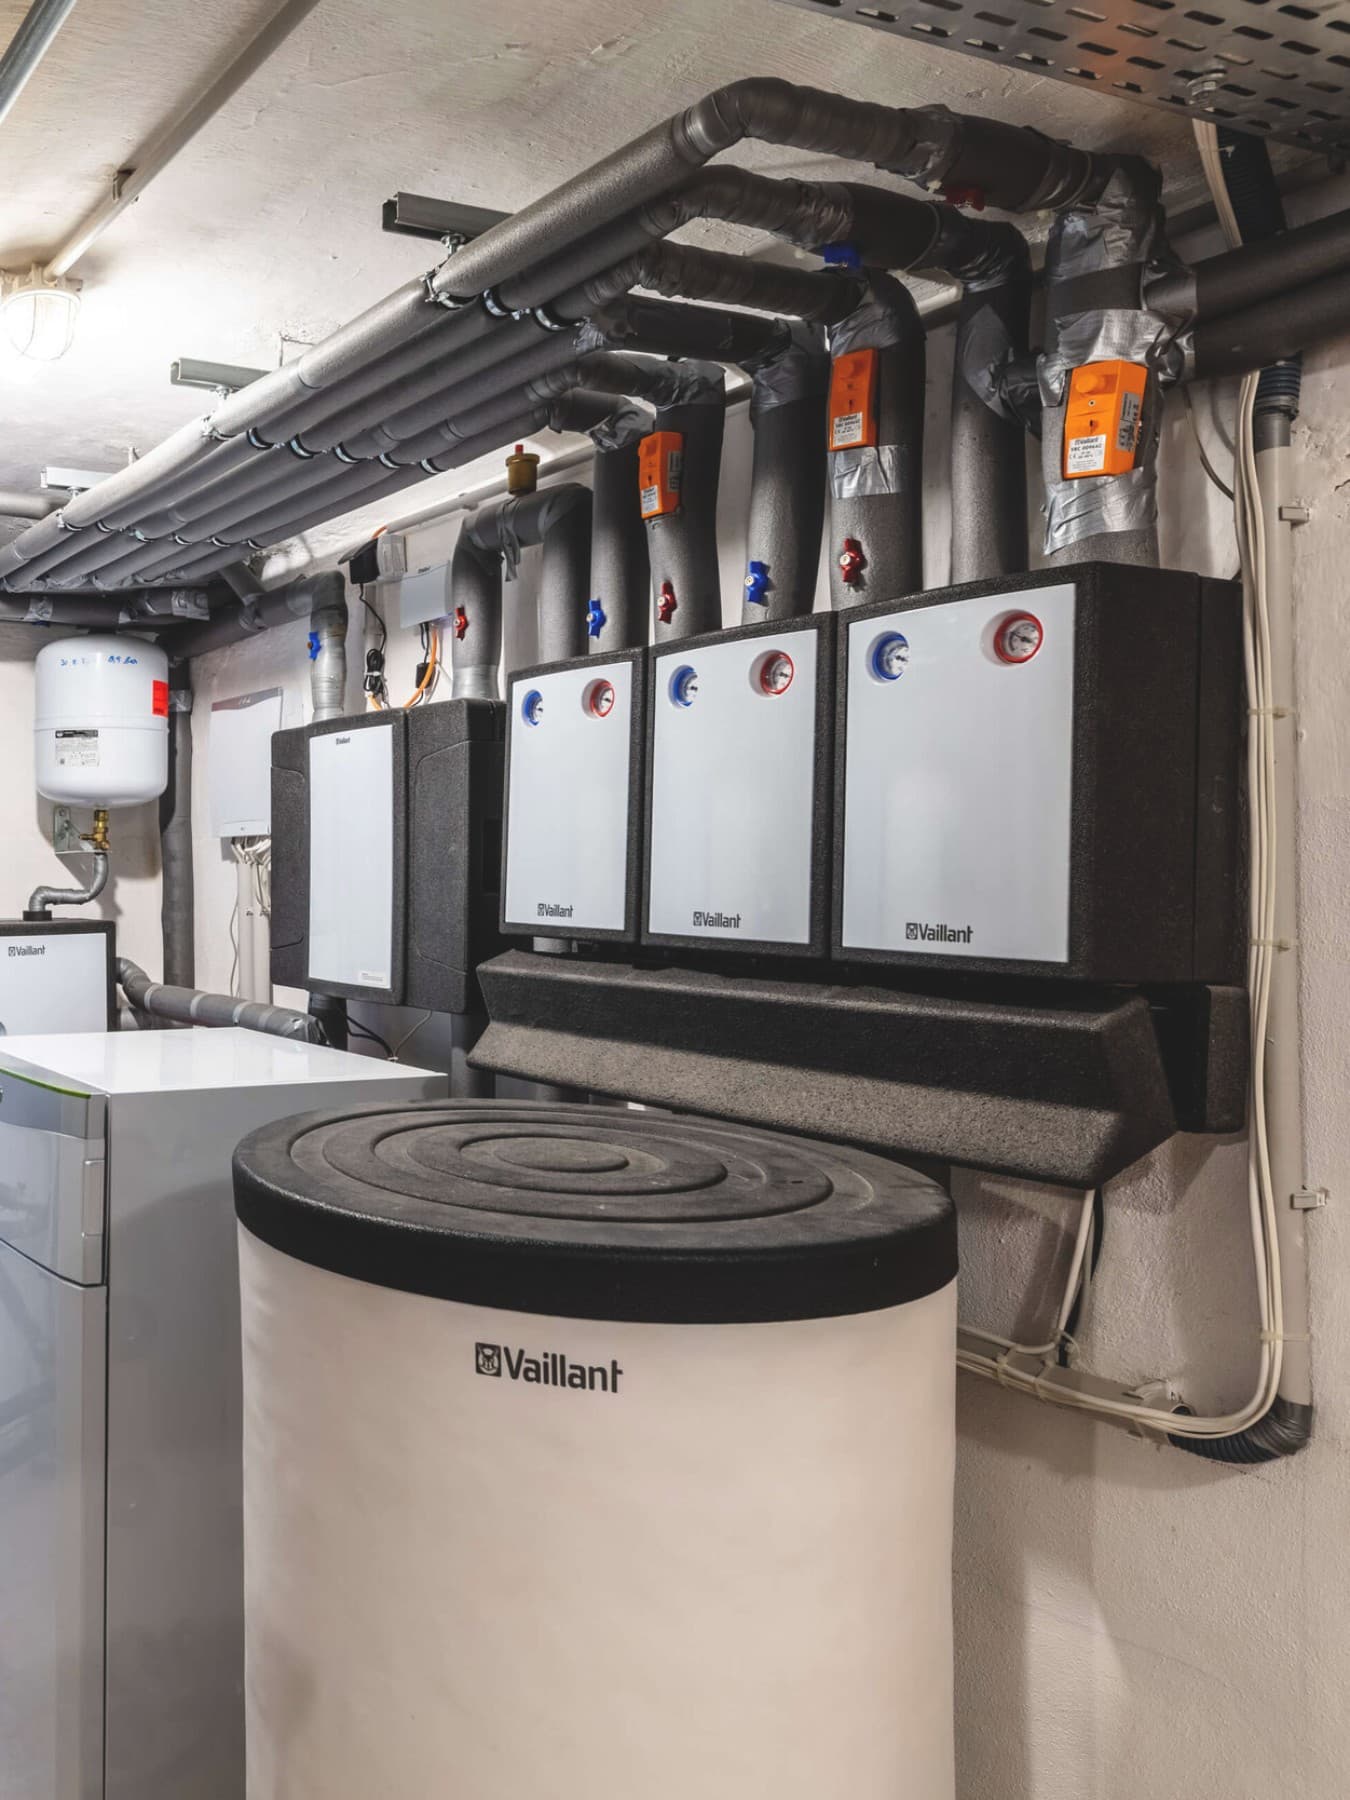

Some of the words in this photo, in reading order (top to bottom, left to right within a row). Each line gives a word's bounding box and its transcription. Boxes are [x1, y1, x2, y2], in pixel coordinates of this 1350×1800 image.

[544, 903, 574, 918] Vaillant
[703, 911, 742, 929] Vaillant
[919, 923, 974, 944] Vaillant
[16, 944, 46, 956] Vaillant
[503, 1346, 623, 1393] Vaillant
